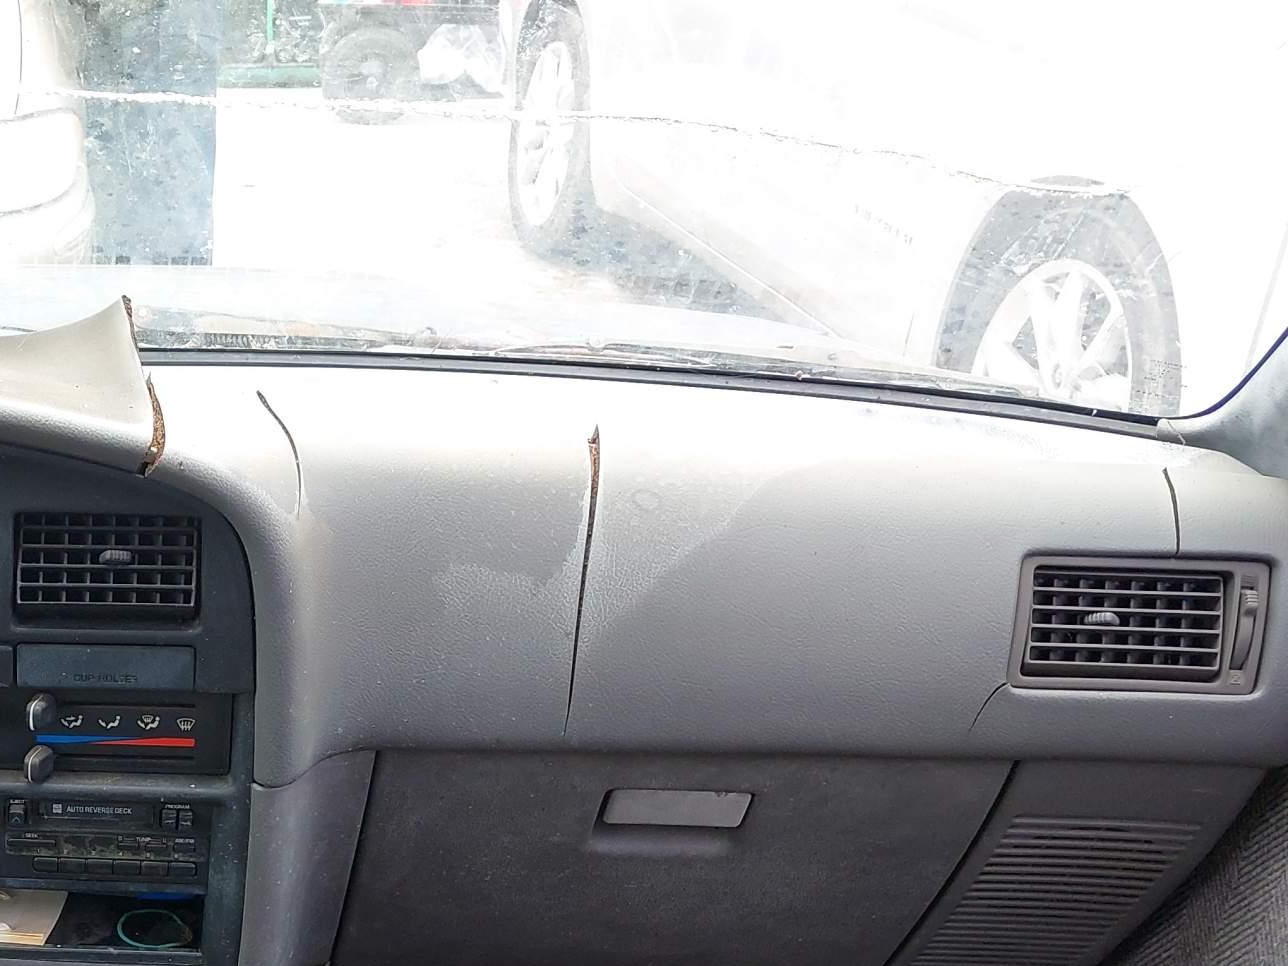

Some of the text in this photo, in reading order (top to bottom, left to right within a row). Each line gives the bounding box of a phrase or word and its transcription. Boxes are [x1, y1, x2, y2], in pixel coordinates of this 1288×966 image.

[65, 805, 133, 815] AUTO REVERSE DECK
